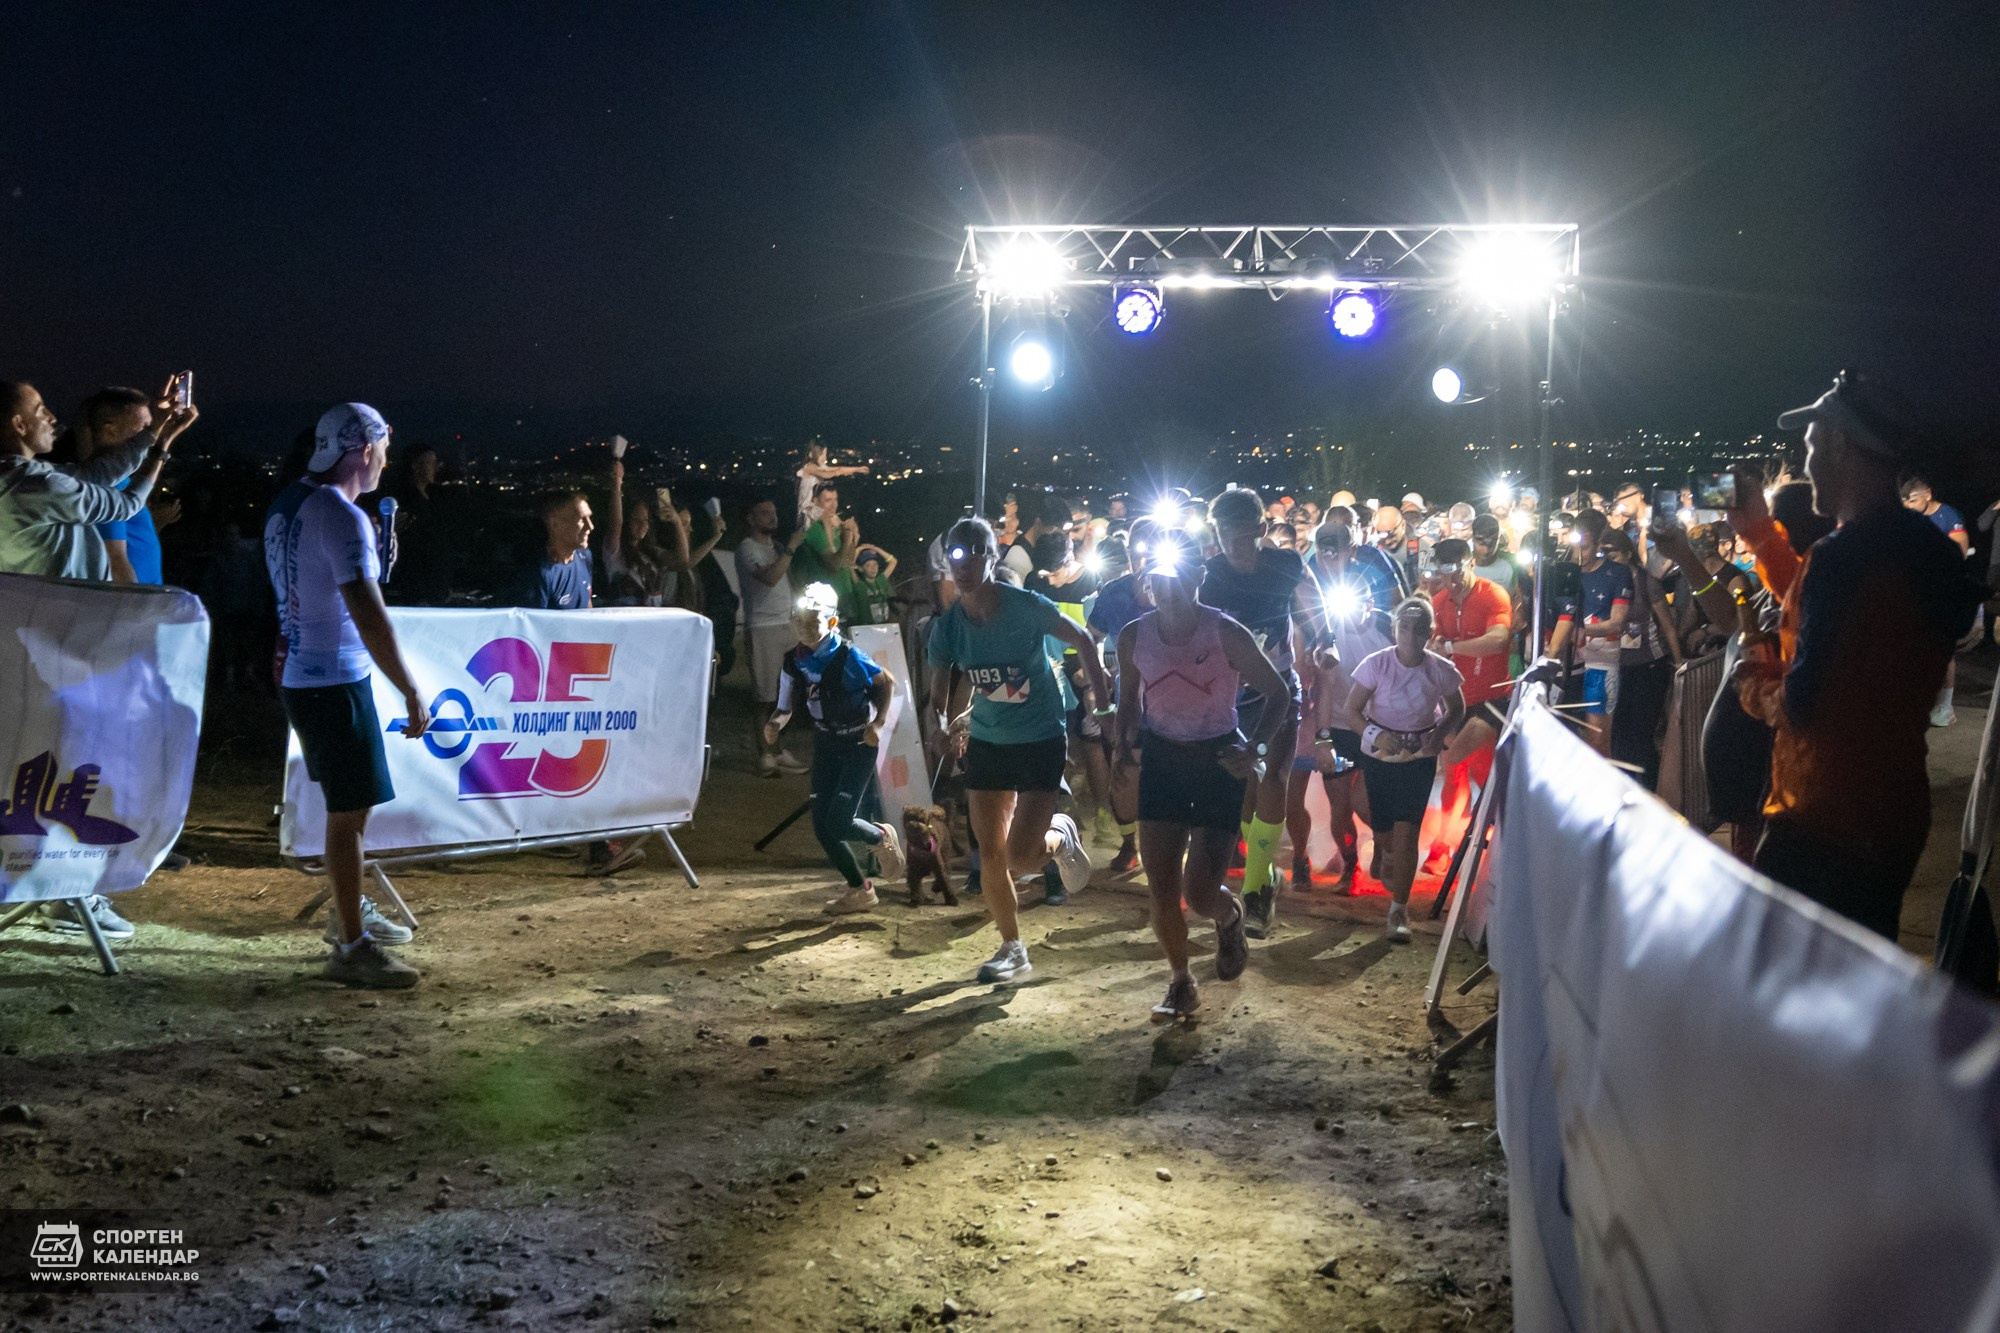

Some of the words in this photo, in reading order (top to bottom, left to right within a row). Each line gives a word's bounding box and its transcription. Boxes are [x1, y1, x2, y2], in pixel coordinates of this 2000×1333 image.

[967, 667, 1002, 684] 1193
[458, 637, 617, 801] 25
[512, 711, 570, 736] ХОЛДИНГ
[573, 711, 602, 734] КЦМ
[605, 710, 637, 731] 2000
[45, 849, 68, 860] water
[69, 848, 82, 859] for
[83, 847, 106, 861] every
